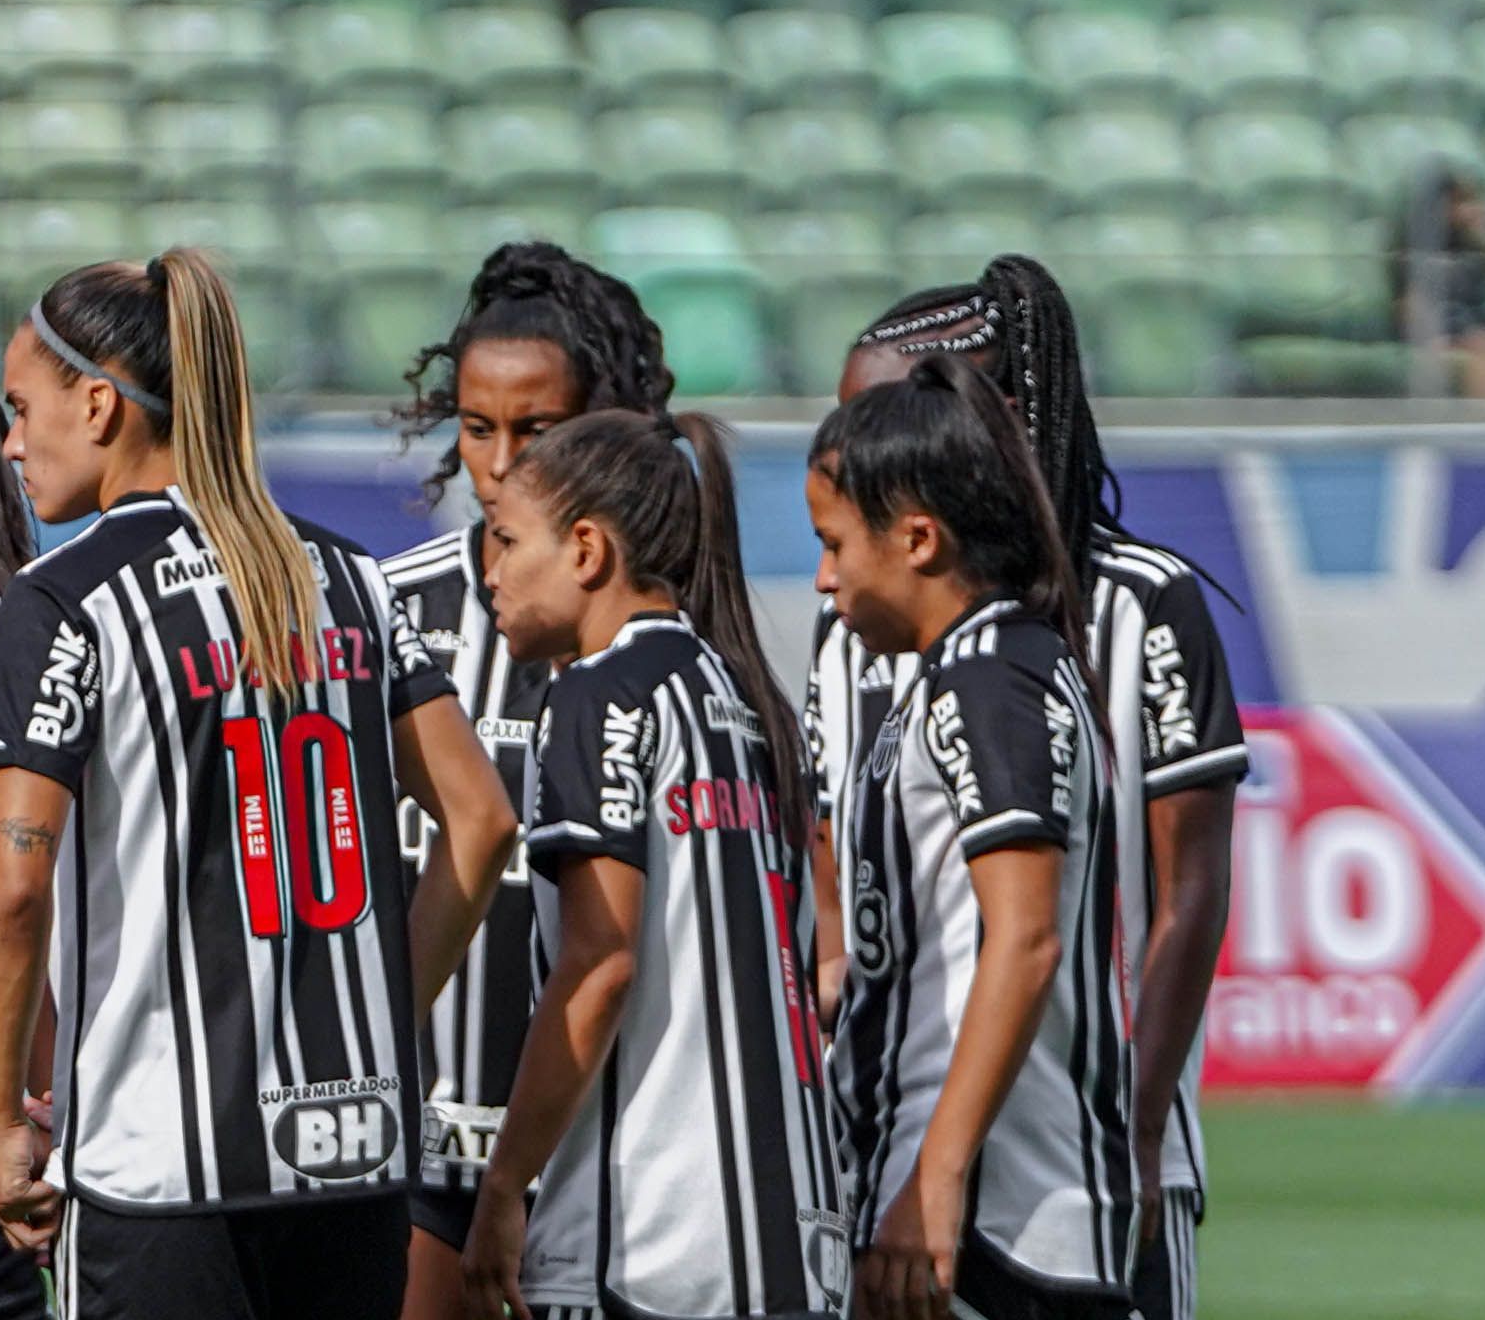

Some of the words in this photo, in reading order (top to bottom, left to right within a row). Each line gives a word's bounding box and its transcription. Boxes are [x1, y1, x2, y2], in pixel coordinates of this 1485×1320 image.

[222, 711, 373, 939] 10
[259, 1077, 401, 1105] SUPERMERCADOS
[295, 1101, 384, 1168] BH
